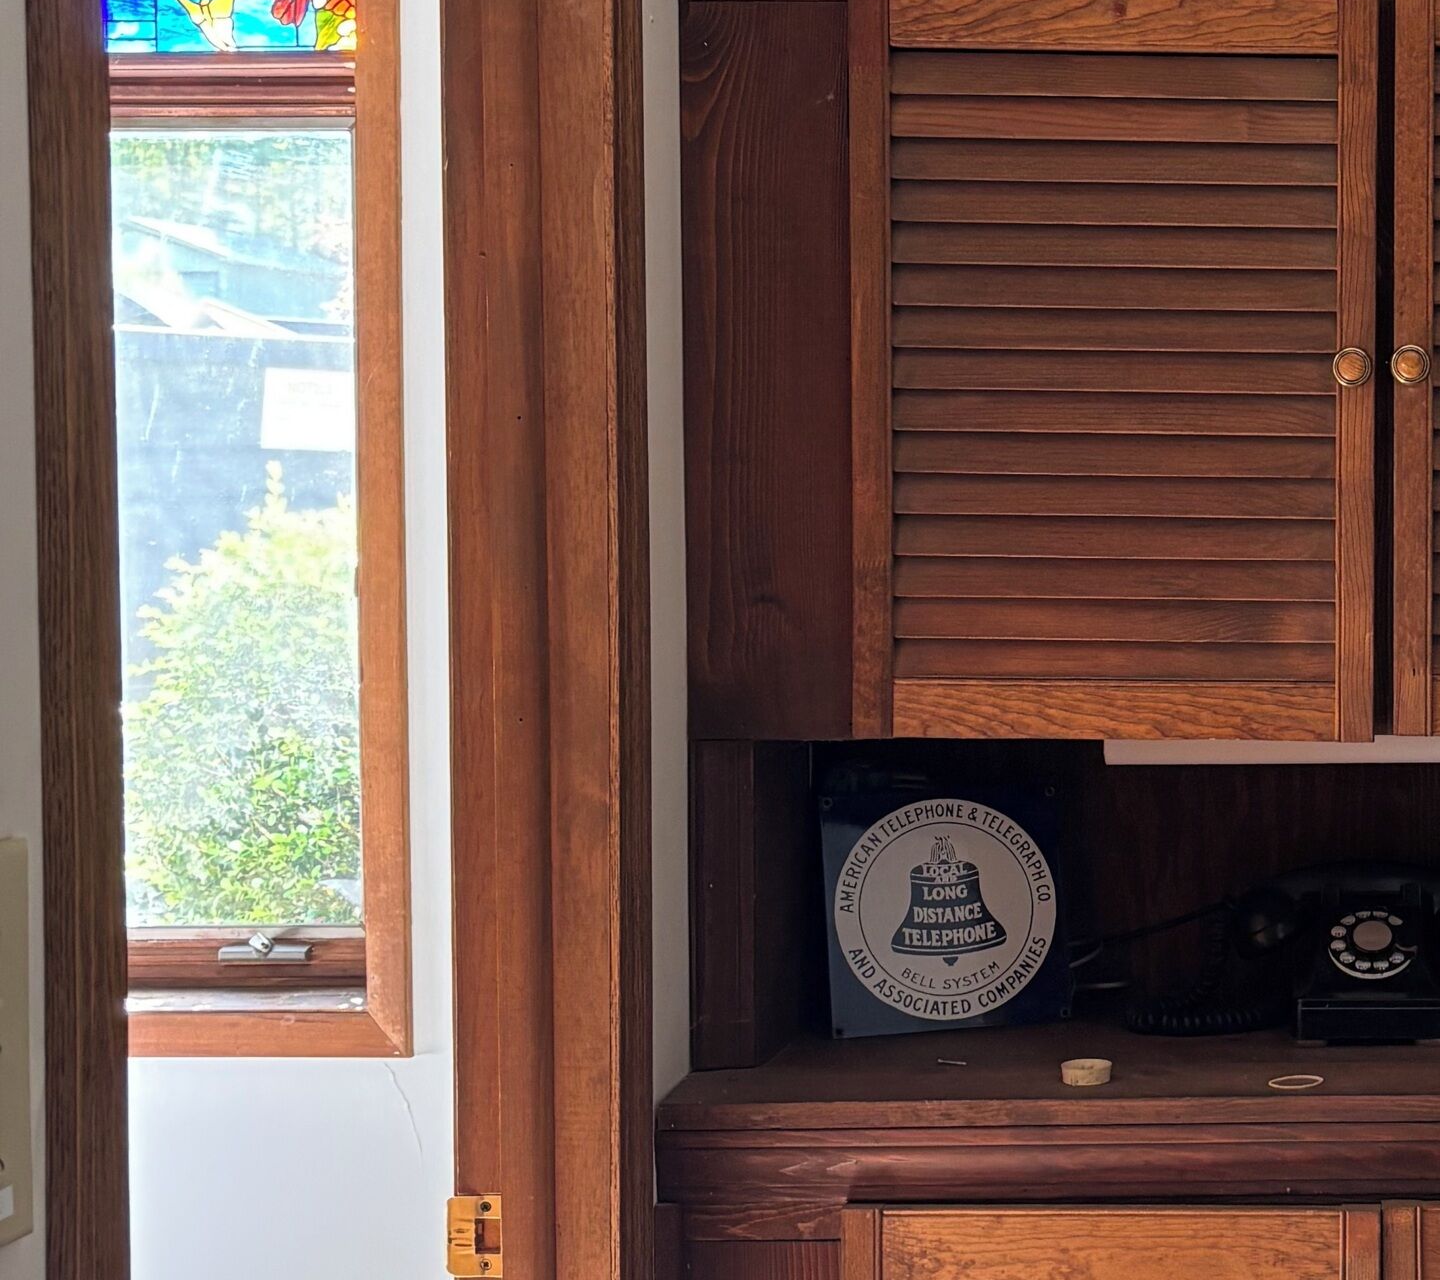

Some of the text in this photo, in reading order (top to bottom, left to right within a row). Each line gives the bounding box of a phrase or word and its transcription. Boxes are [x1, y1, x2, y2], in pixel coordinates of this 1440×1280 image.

[840, 833, 882, 913] AMERICAN
[879, 804, 964, 836] TELEPHONE
[968, 808, 977, 820] &
[982, 812, 1046, 882] TELEGRAPH
[923, 864, 967, 876] LOCAL
[923, 884, 968, 901] LONG
[913, 902, 982, 924] DISTANCE
[902, 921, 996, 947] TELEPHONE
[848, 937, 1046, 1015] AND ASSOCIATED COMPANIES
[901, 962, 1000, 989] BELL SYSTEM
